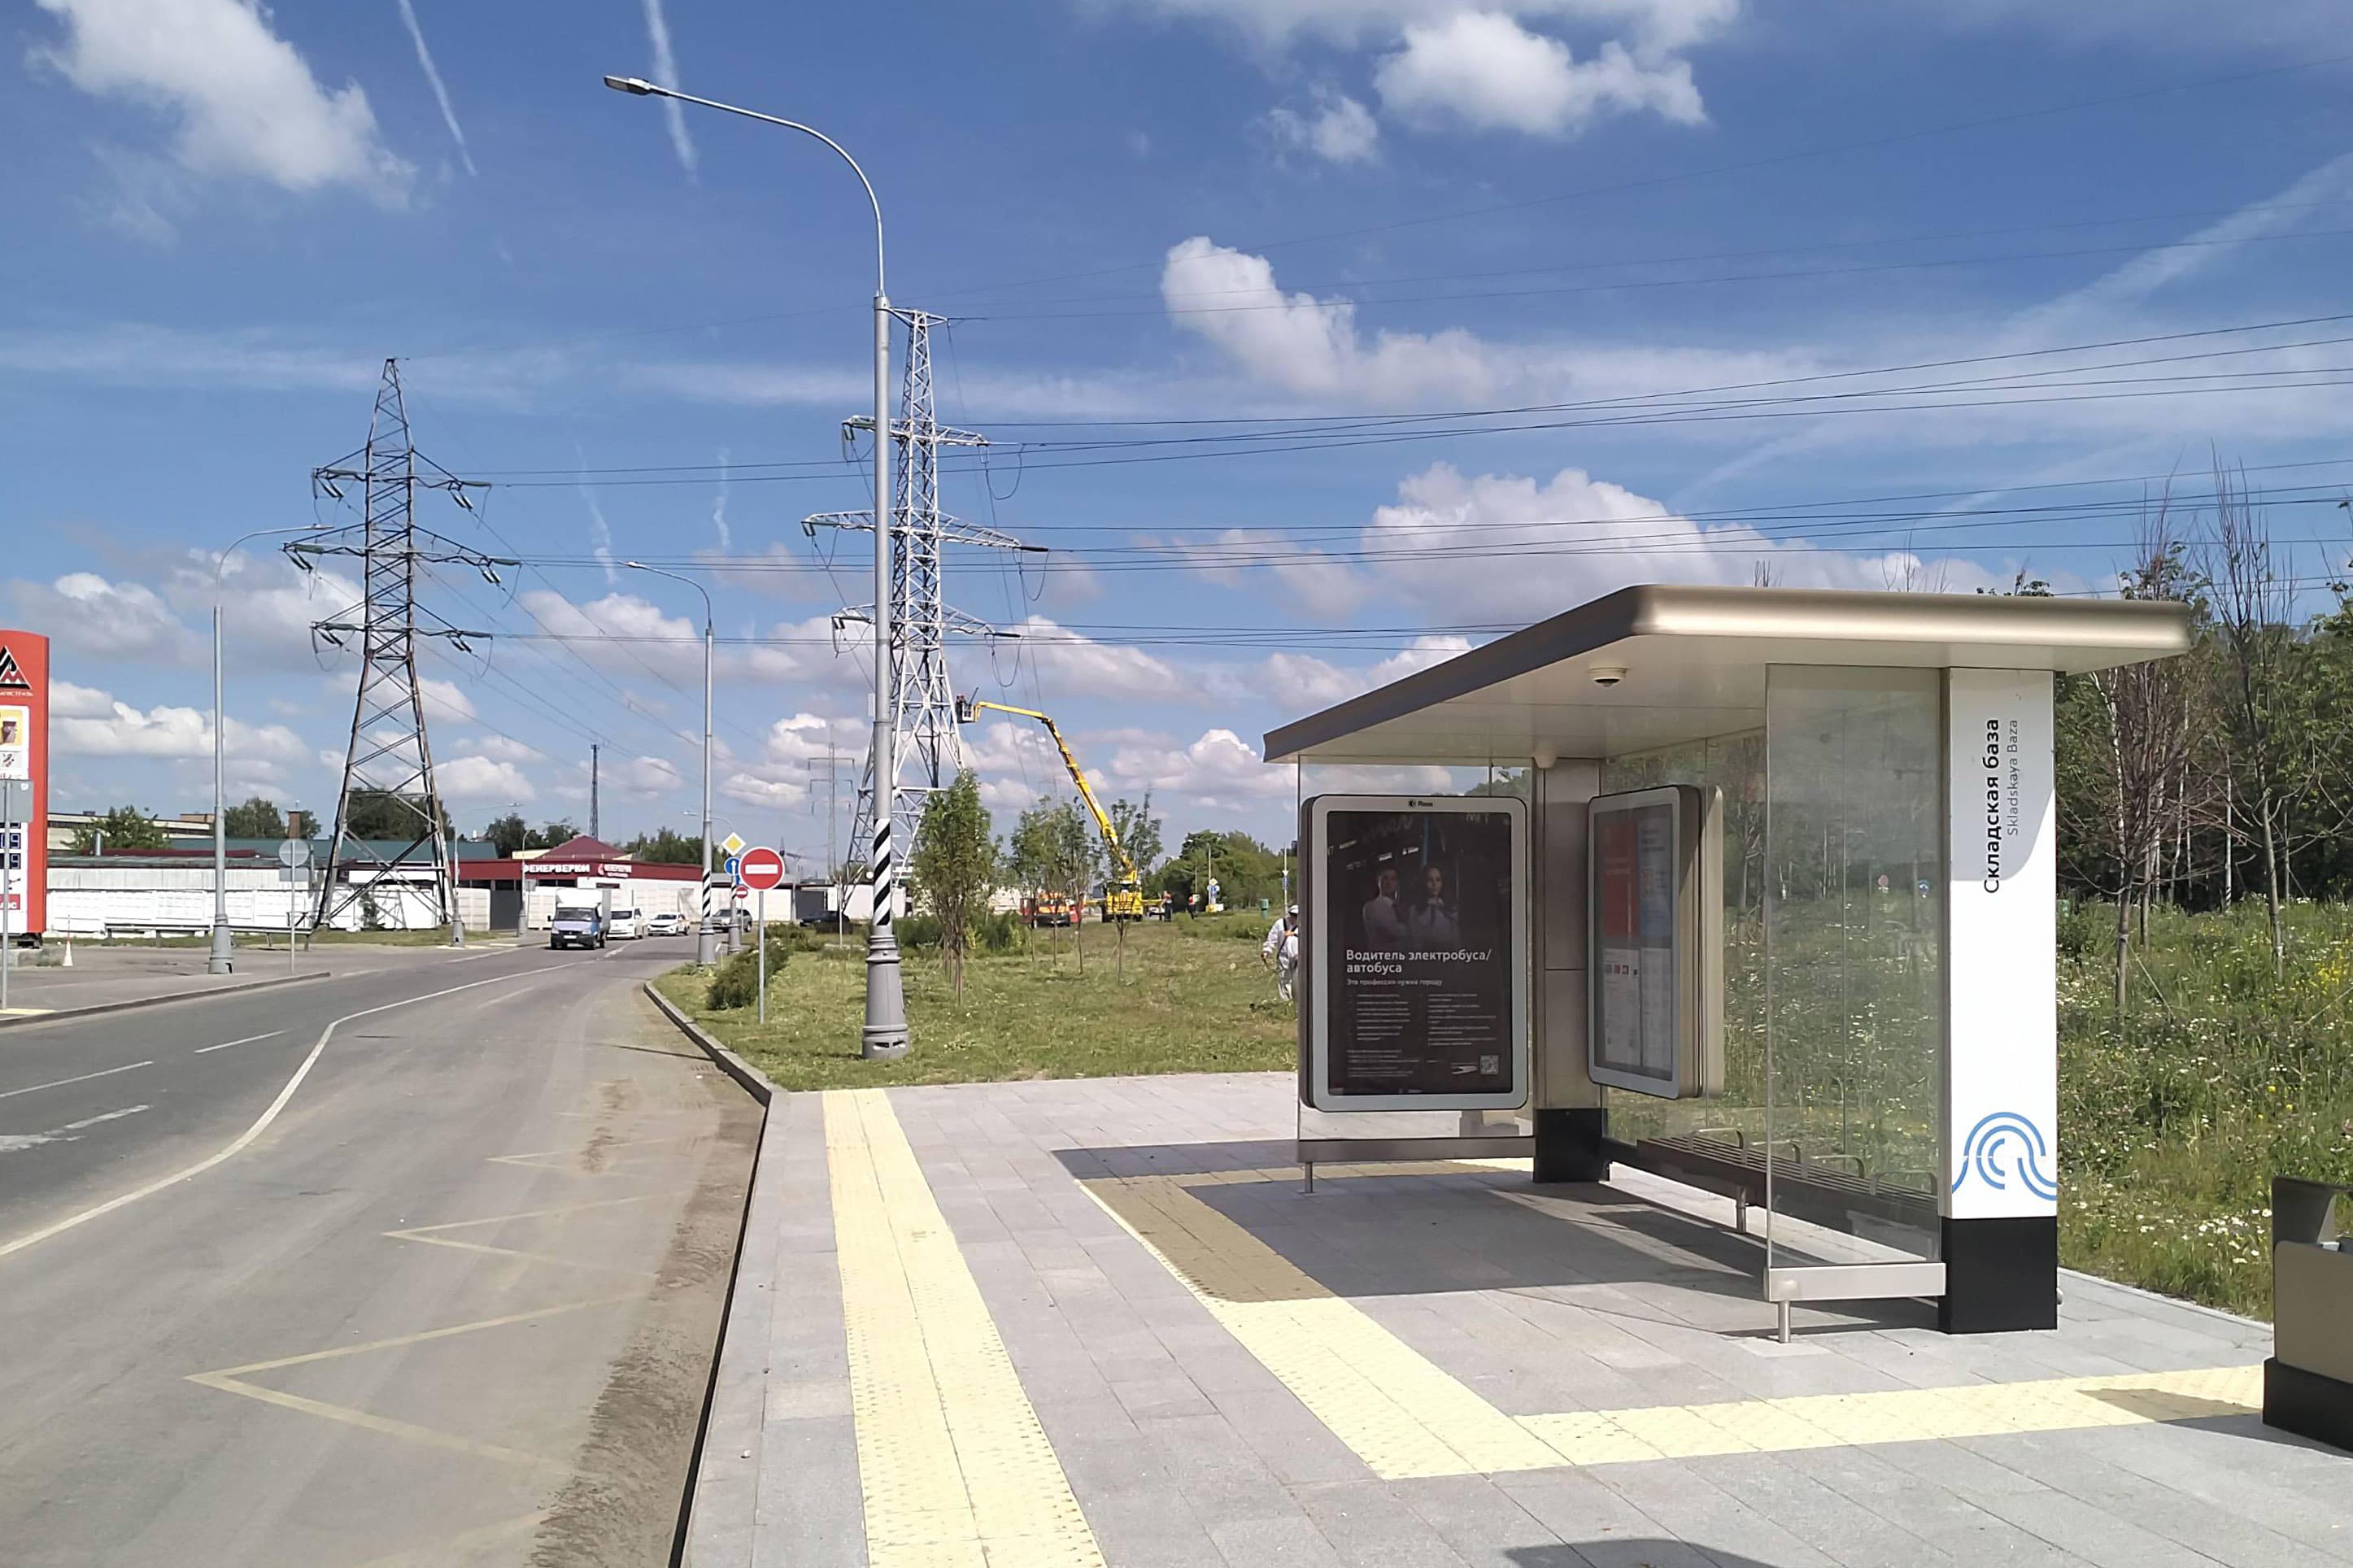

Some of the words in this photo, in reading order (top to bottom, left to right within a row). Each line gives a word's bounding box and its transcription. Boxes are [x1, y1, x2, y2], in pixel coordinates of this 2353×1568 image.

[1982, 719, 1999, 769] база
[2007, 720, 2018, 752] Baza
[2007, 757, 2020, 835] Skladskaya
[1983, 776, 2002, 893] Складская
[1346, 949, 1405, 961] Водитель
[1408, 949, 1492, 962] электробуса/
[1346, 962, 1402, 975] автобуса
